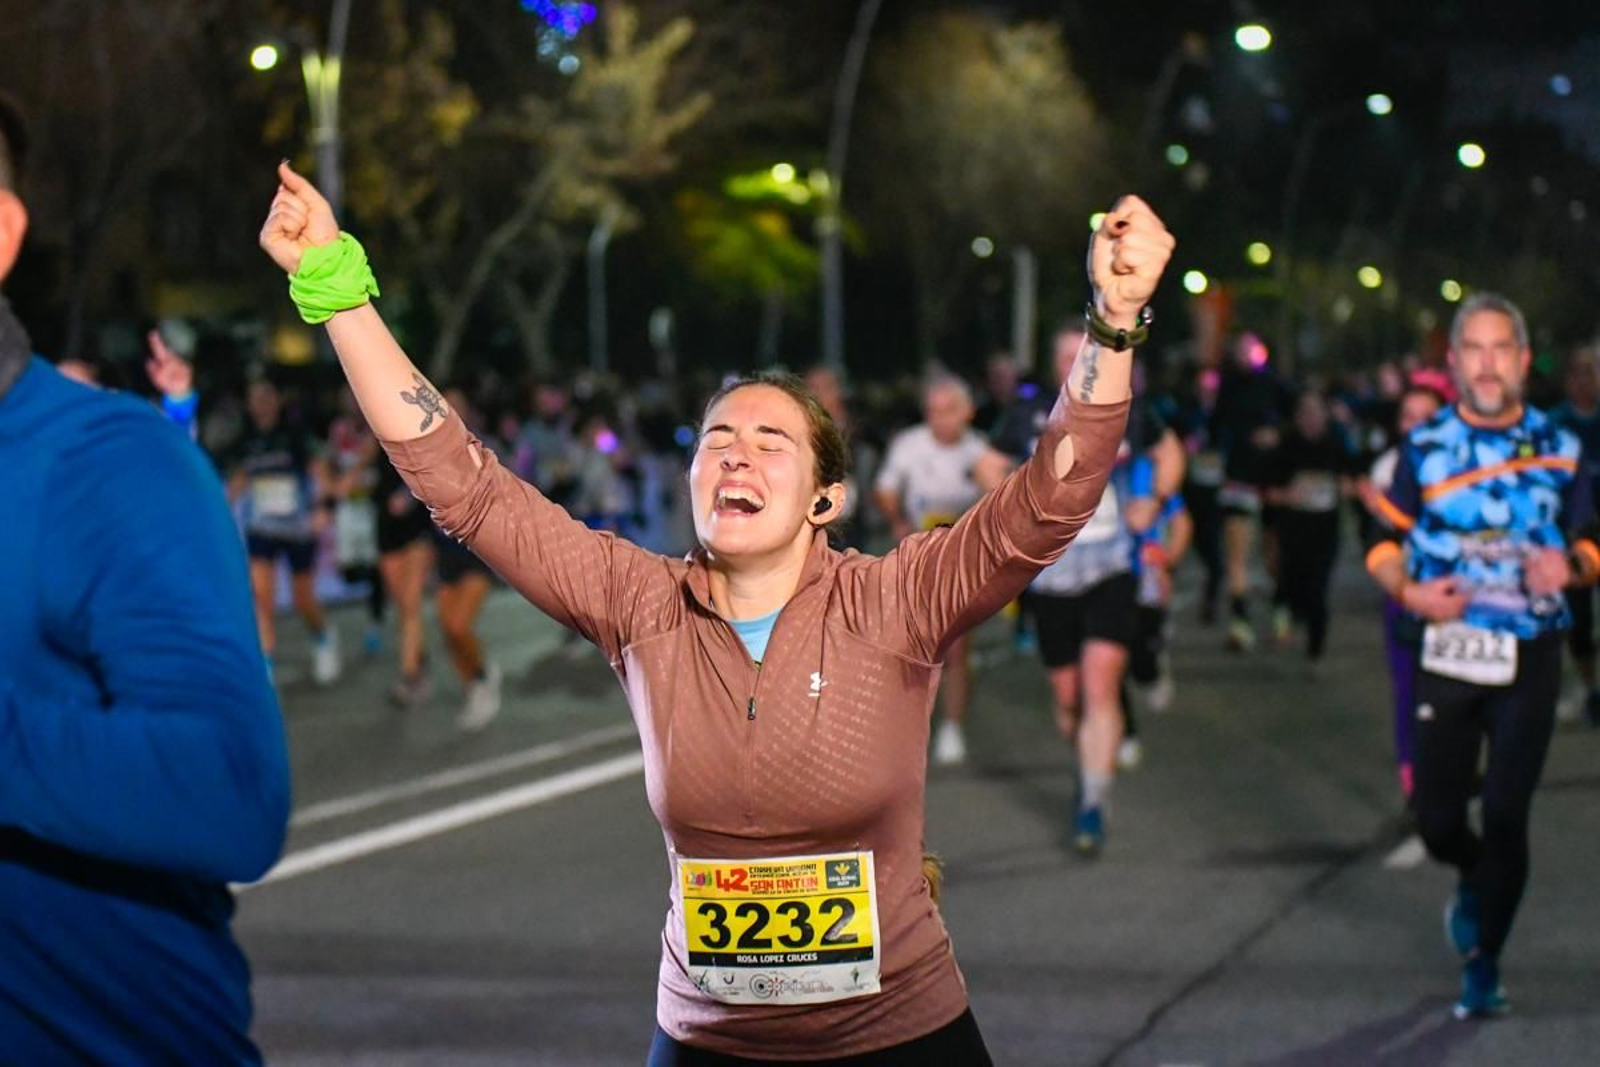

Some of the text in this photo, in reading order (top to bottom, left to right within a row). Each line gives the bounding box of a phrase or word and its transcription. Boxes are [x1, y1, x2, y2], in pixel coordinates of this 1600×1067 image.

[716, 868, 749, 892] 42
[750, 879, 774, 891] SAN
[697, 897, 859, 949] 3232
[736, 952, 818, 964] ROSA LOPEZ CRUCES
